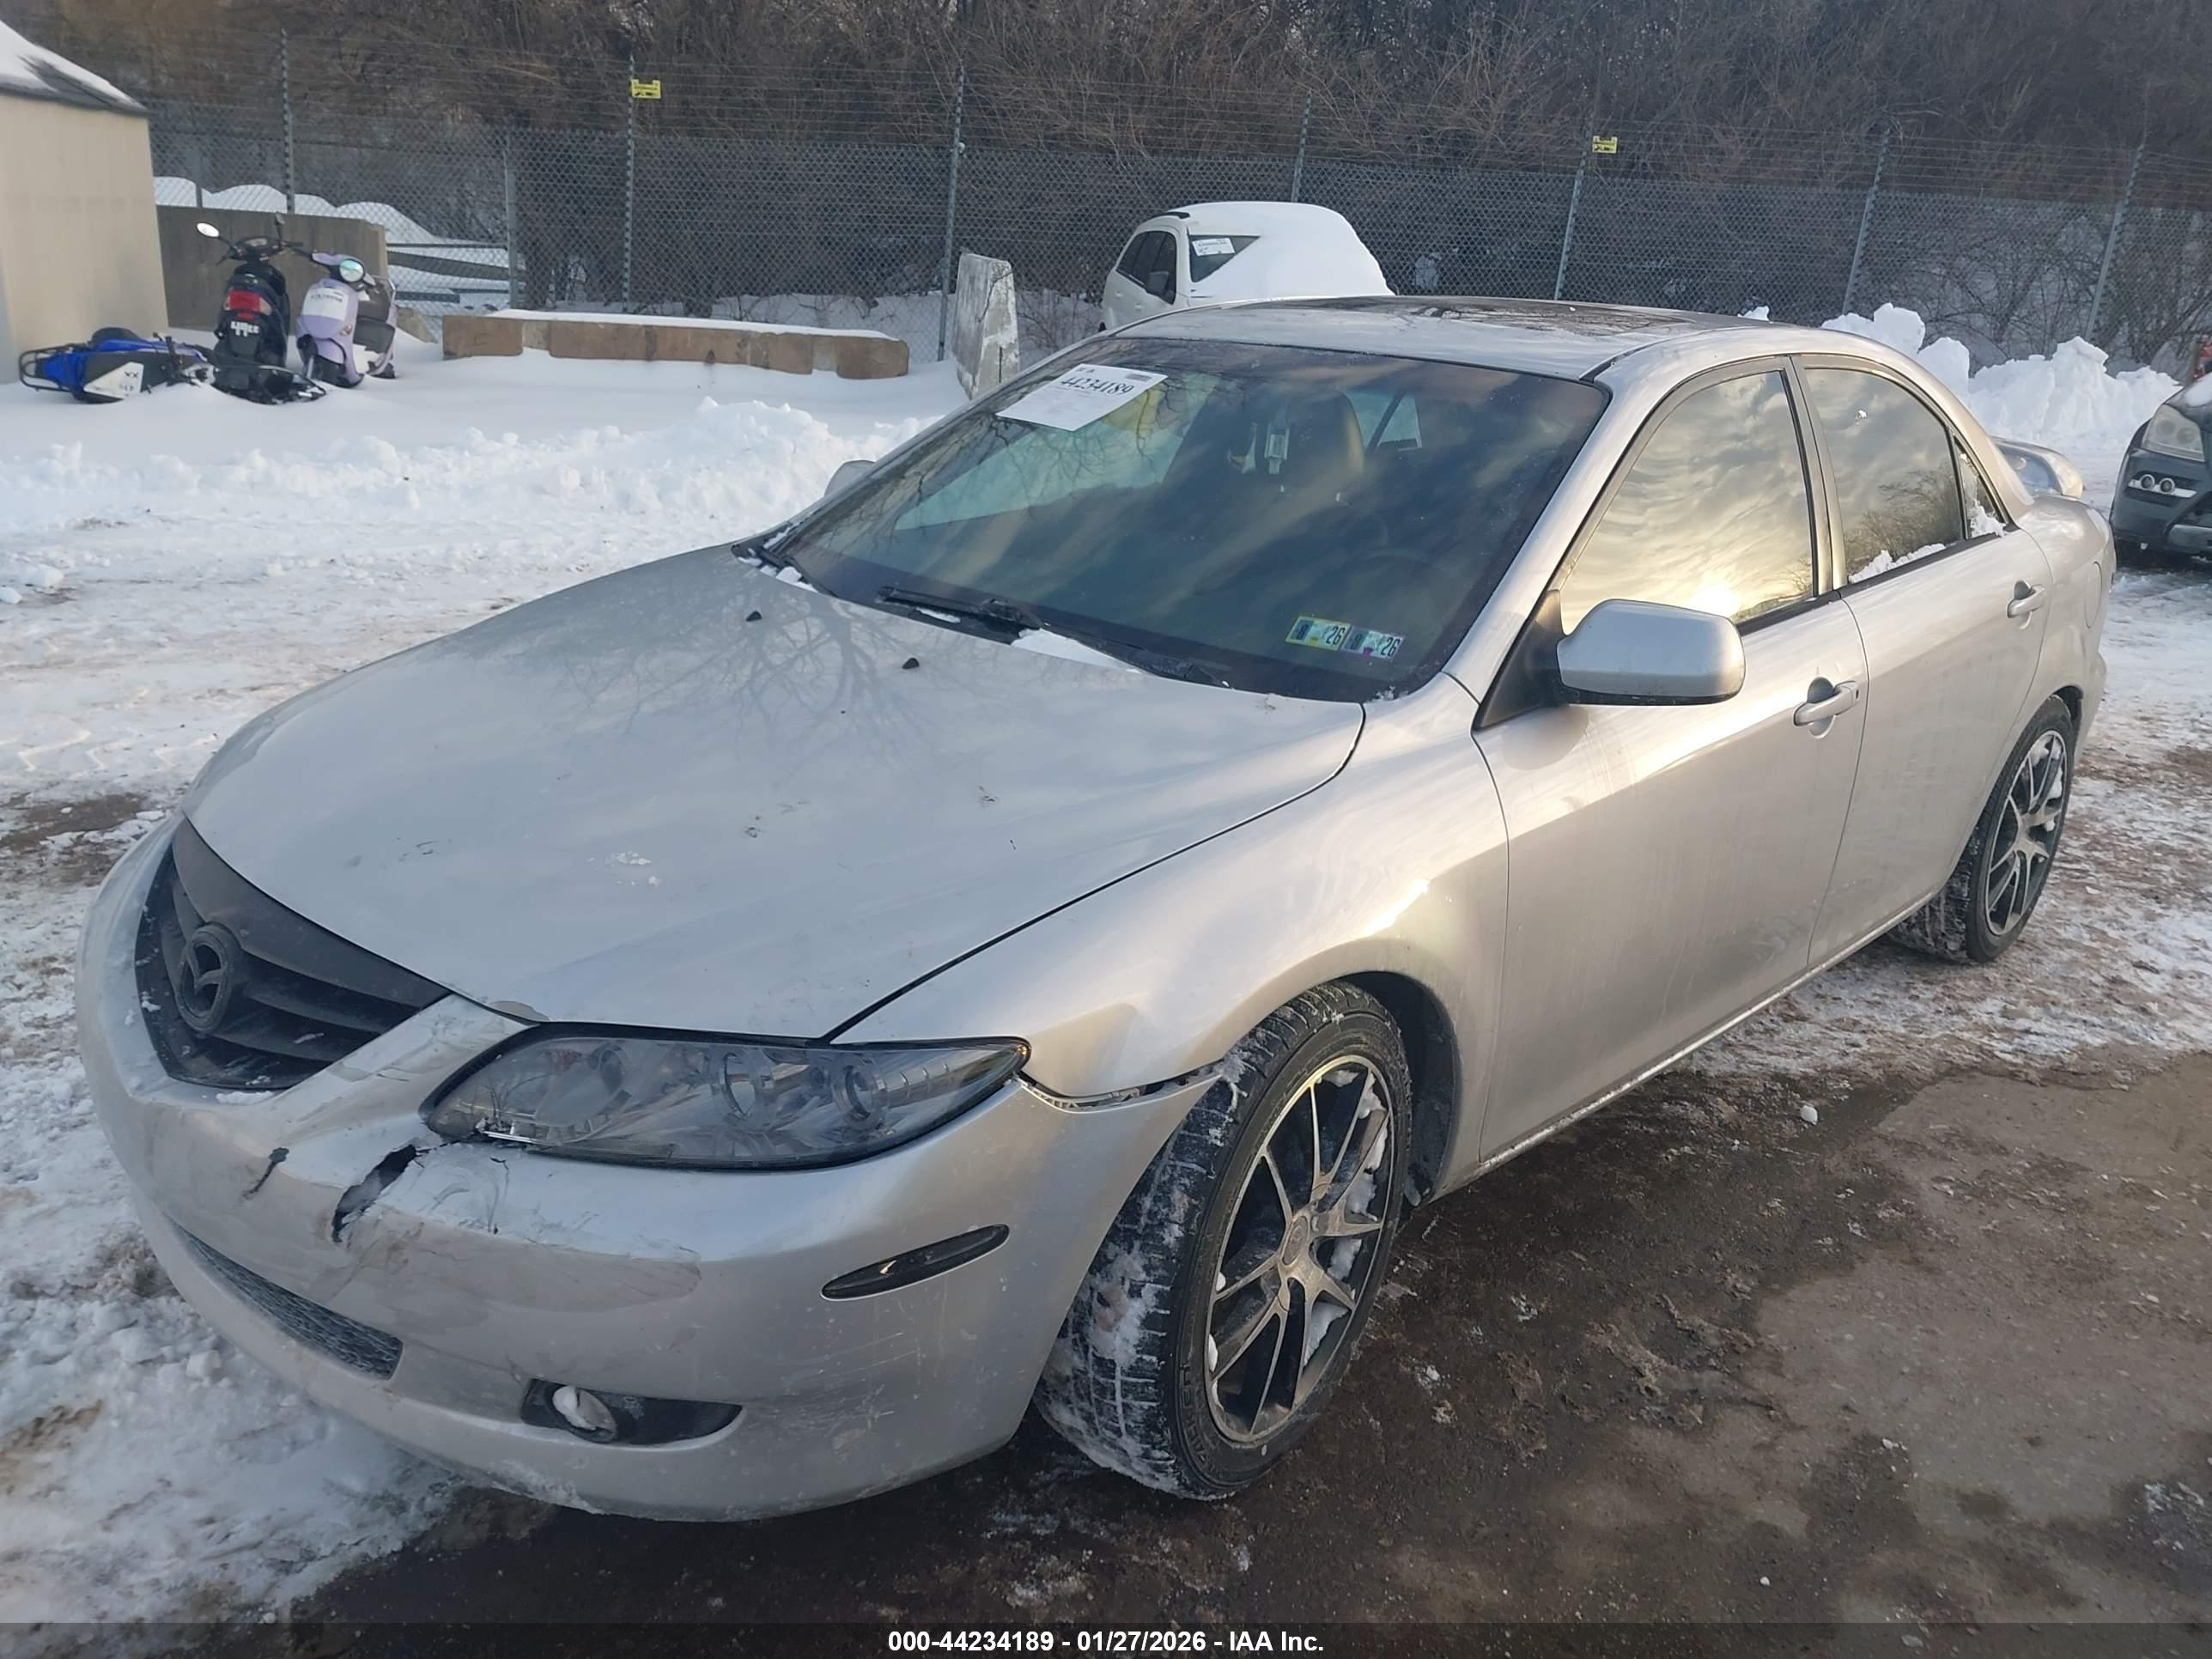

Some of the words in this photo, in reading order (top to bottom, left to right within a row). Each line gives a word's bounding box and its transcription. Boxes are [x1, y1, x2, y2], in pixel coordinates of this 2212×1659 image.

[1060, 376, 1134, 395] 44234189
[1326, 626, 1346, 646] 26
[1381, 637, 1401, 657] 26
